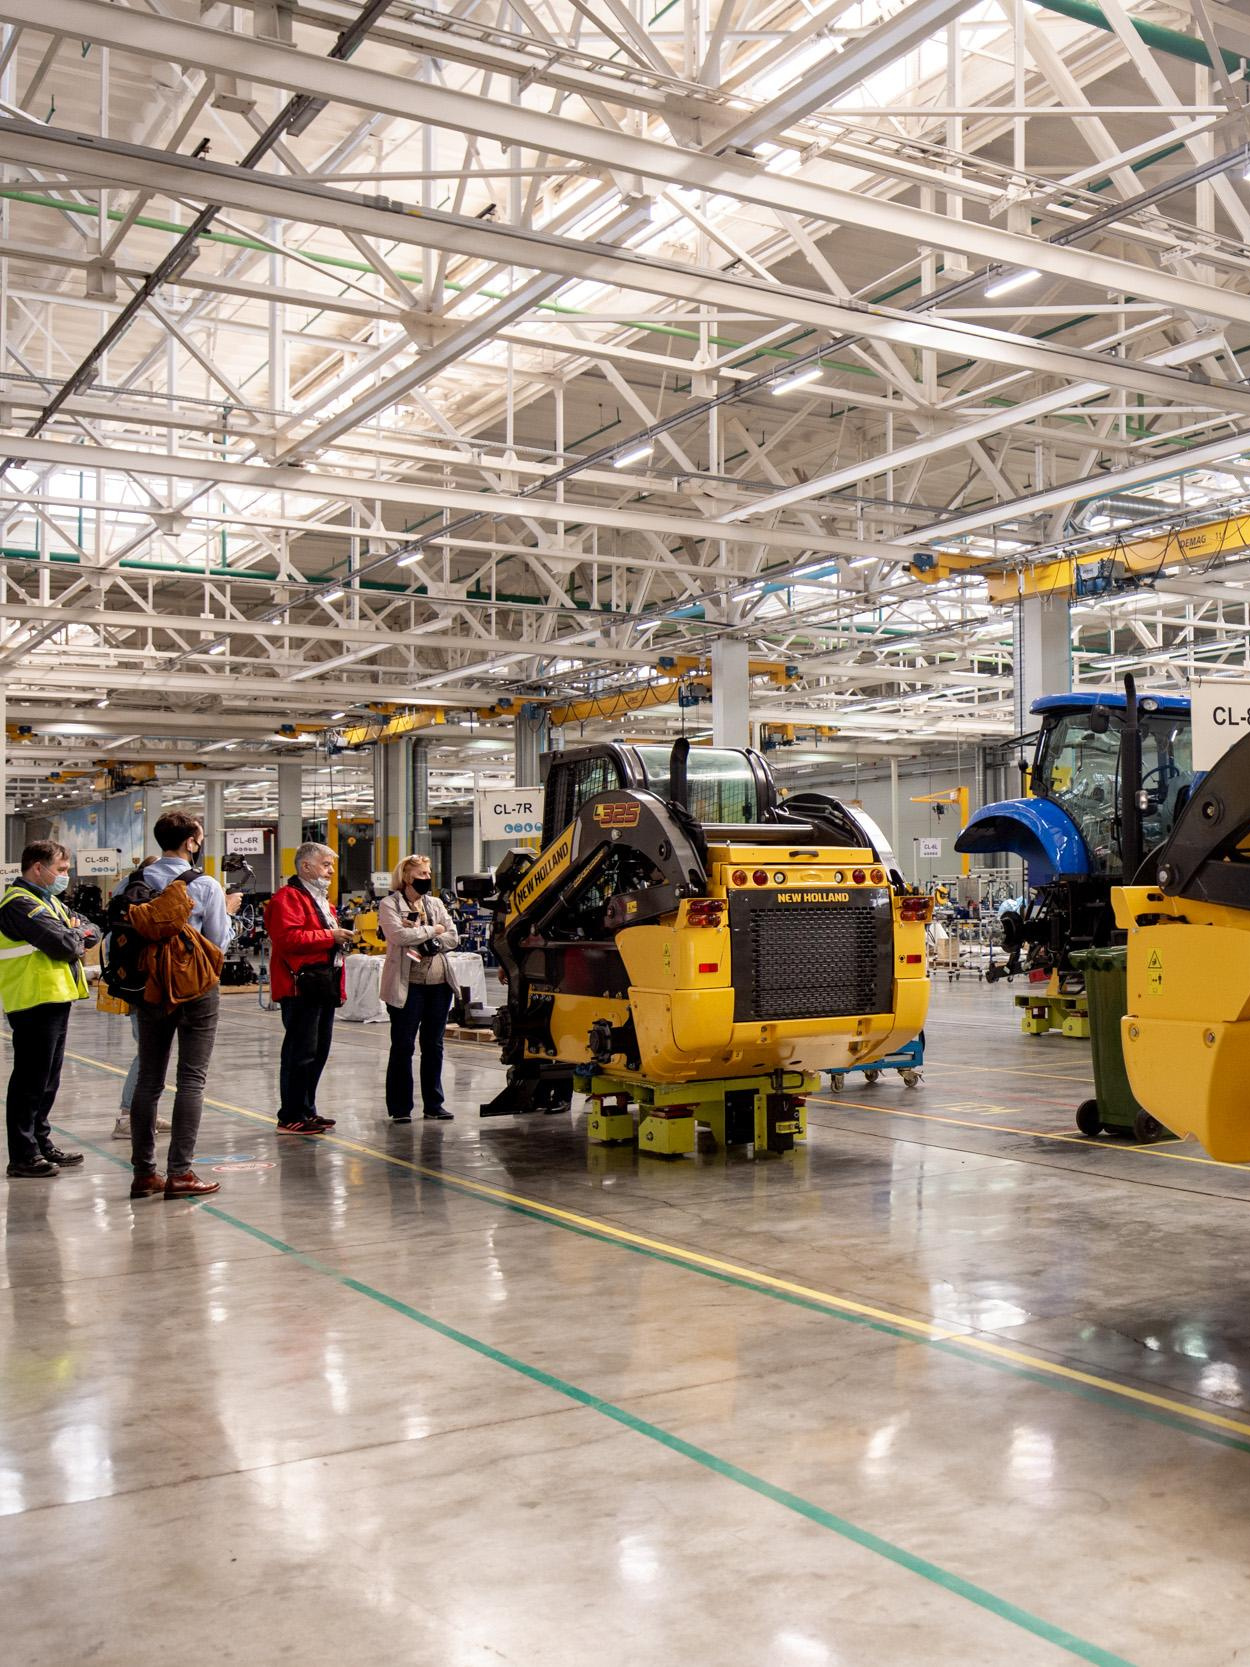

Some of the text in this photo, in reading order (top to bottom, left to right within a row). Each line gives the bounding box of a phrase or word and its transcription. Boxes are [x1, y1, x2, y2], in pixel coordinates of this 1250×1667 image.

[1180, 535, 1207, 548] DEMAG
[493, 803, 533, 815] CL-7R
[593, 802, 641, 828] L325
[233, 836, 258, 844] CL-6R
[85, 856, 109, 864] CL-5R
[517, 842, 569, 906] NEW HOLLAND
[777, 892, 849, 903] NEW HOLLAND
